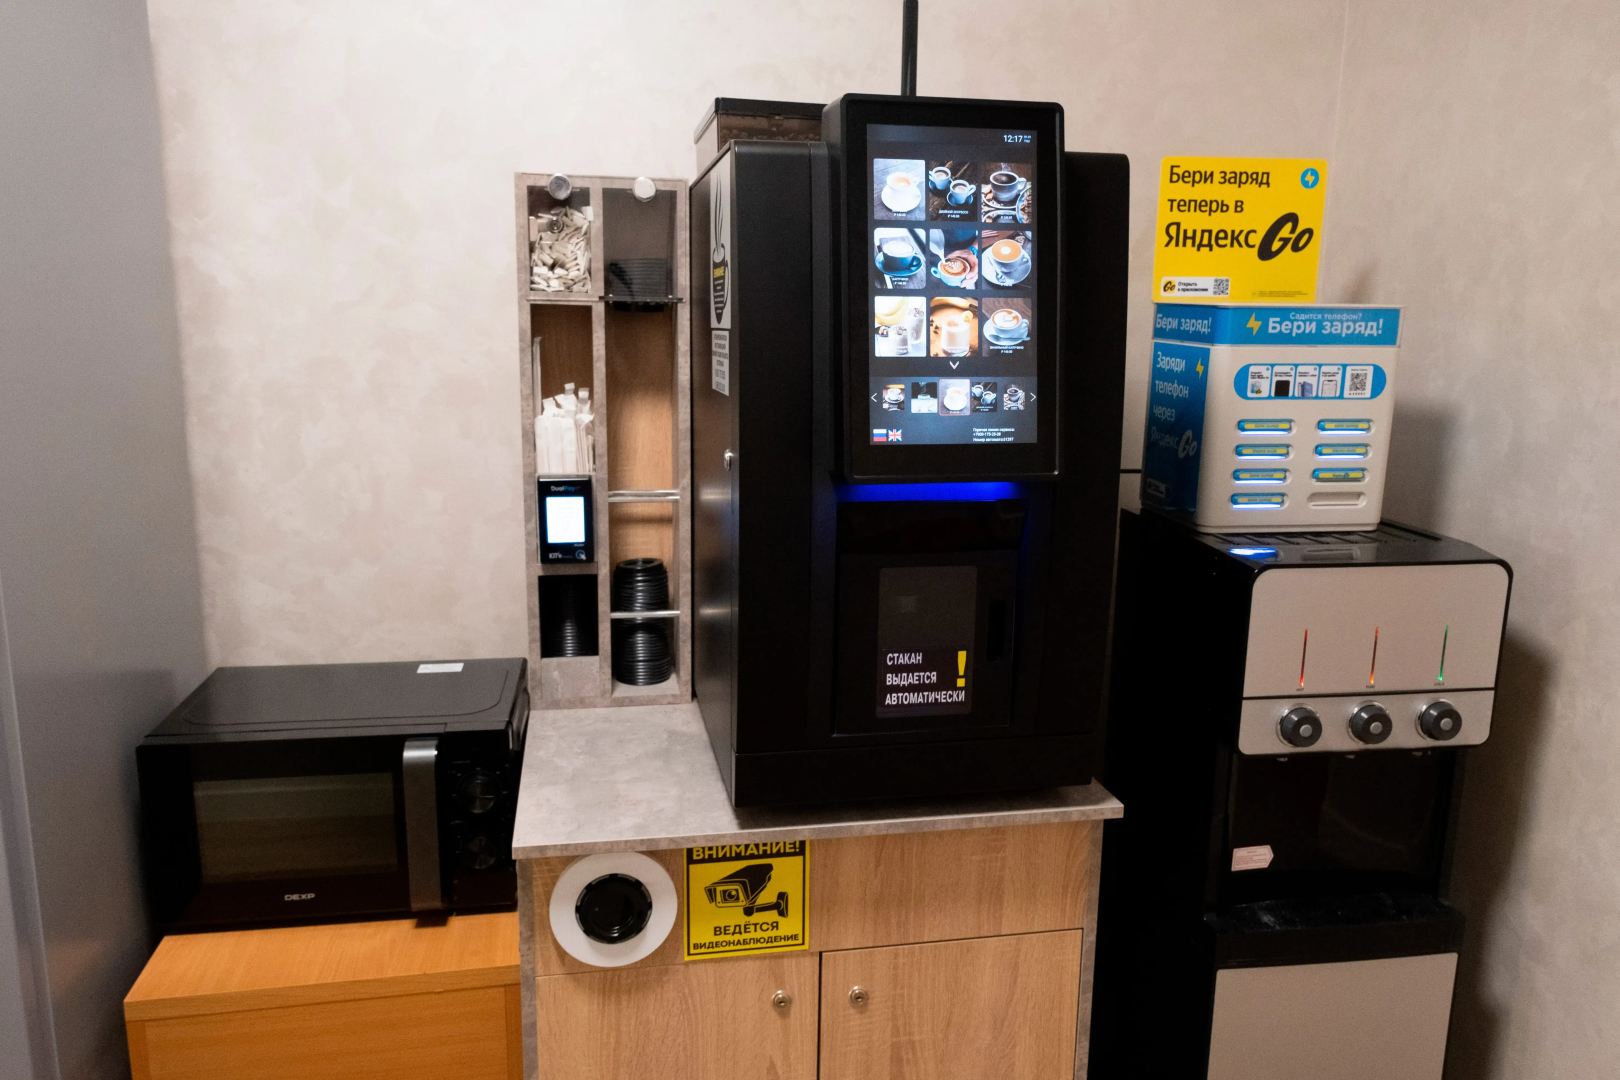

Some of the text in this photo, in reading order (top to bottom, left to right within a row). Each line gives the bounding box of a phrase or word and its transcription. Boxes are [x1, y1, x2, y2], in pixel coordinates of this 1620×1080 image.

[1003, 134, 1023, 143] 12:17
[1169, 165, 1270, 188] Бери заряд
[1167, 198, 1244, 216] теперь в
[1164, 212, 1314, 261] Яндекс Go
[1155, 314, 1212, 334] Бери заряд!
[1289, 312, 1362, 321] Садится телефон?
[1268, 317, 1383, 337] Бери заряд!
[1156, 351, 1186, 373] Заряди
[1155, 380, 1189, 399] телефон
[1152, 405, 1176, 422] через
[1151, 426, 1198, 458] Яндекс Go
[886, 652, 923, 666] СТАКАН
[886, 671, 937, 687] ВЫДАЕТСЯ
[885, 690, 965, 705] АВТОМАТИЧЕСКИ
[692, 840, 800, 860] ВНИМАНИЕ!
[284, 893, 316, 901] DEXP
[713, 920, 779, 937] ВЕДЁТСЯ
[693, 933, 800, 950] ВИДЕОНАБЛЮДЕНИЕ
